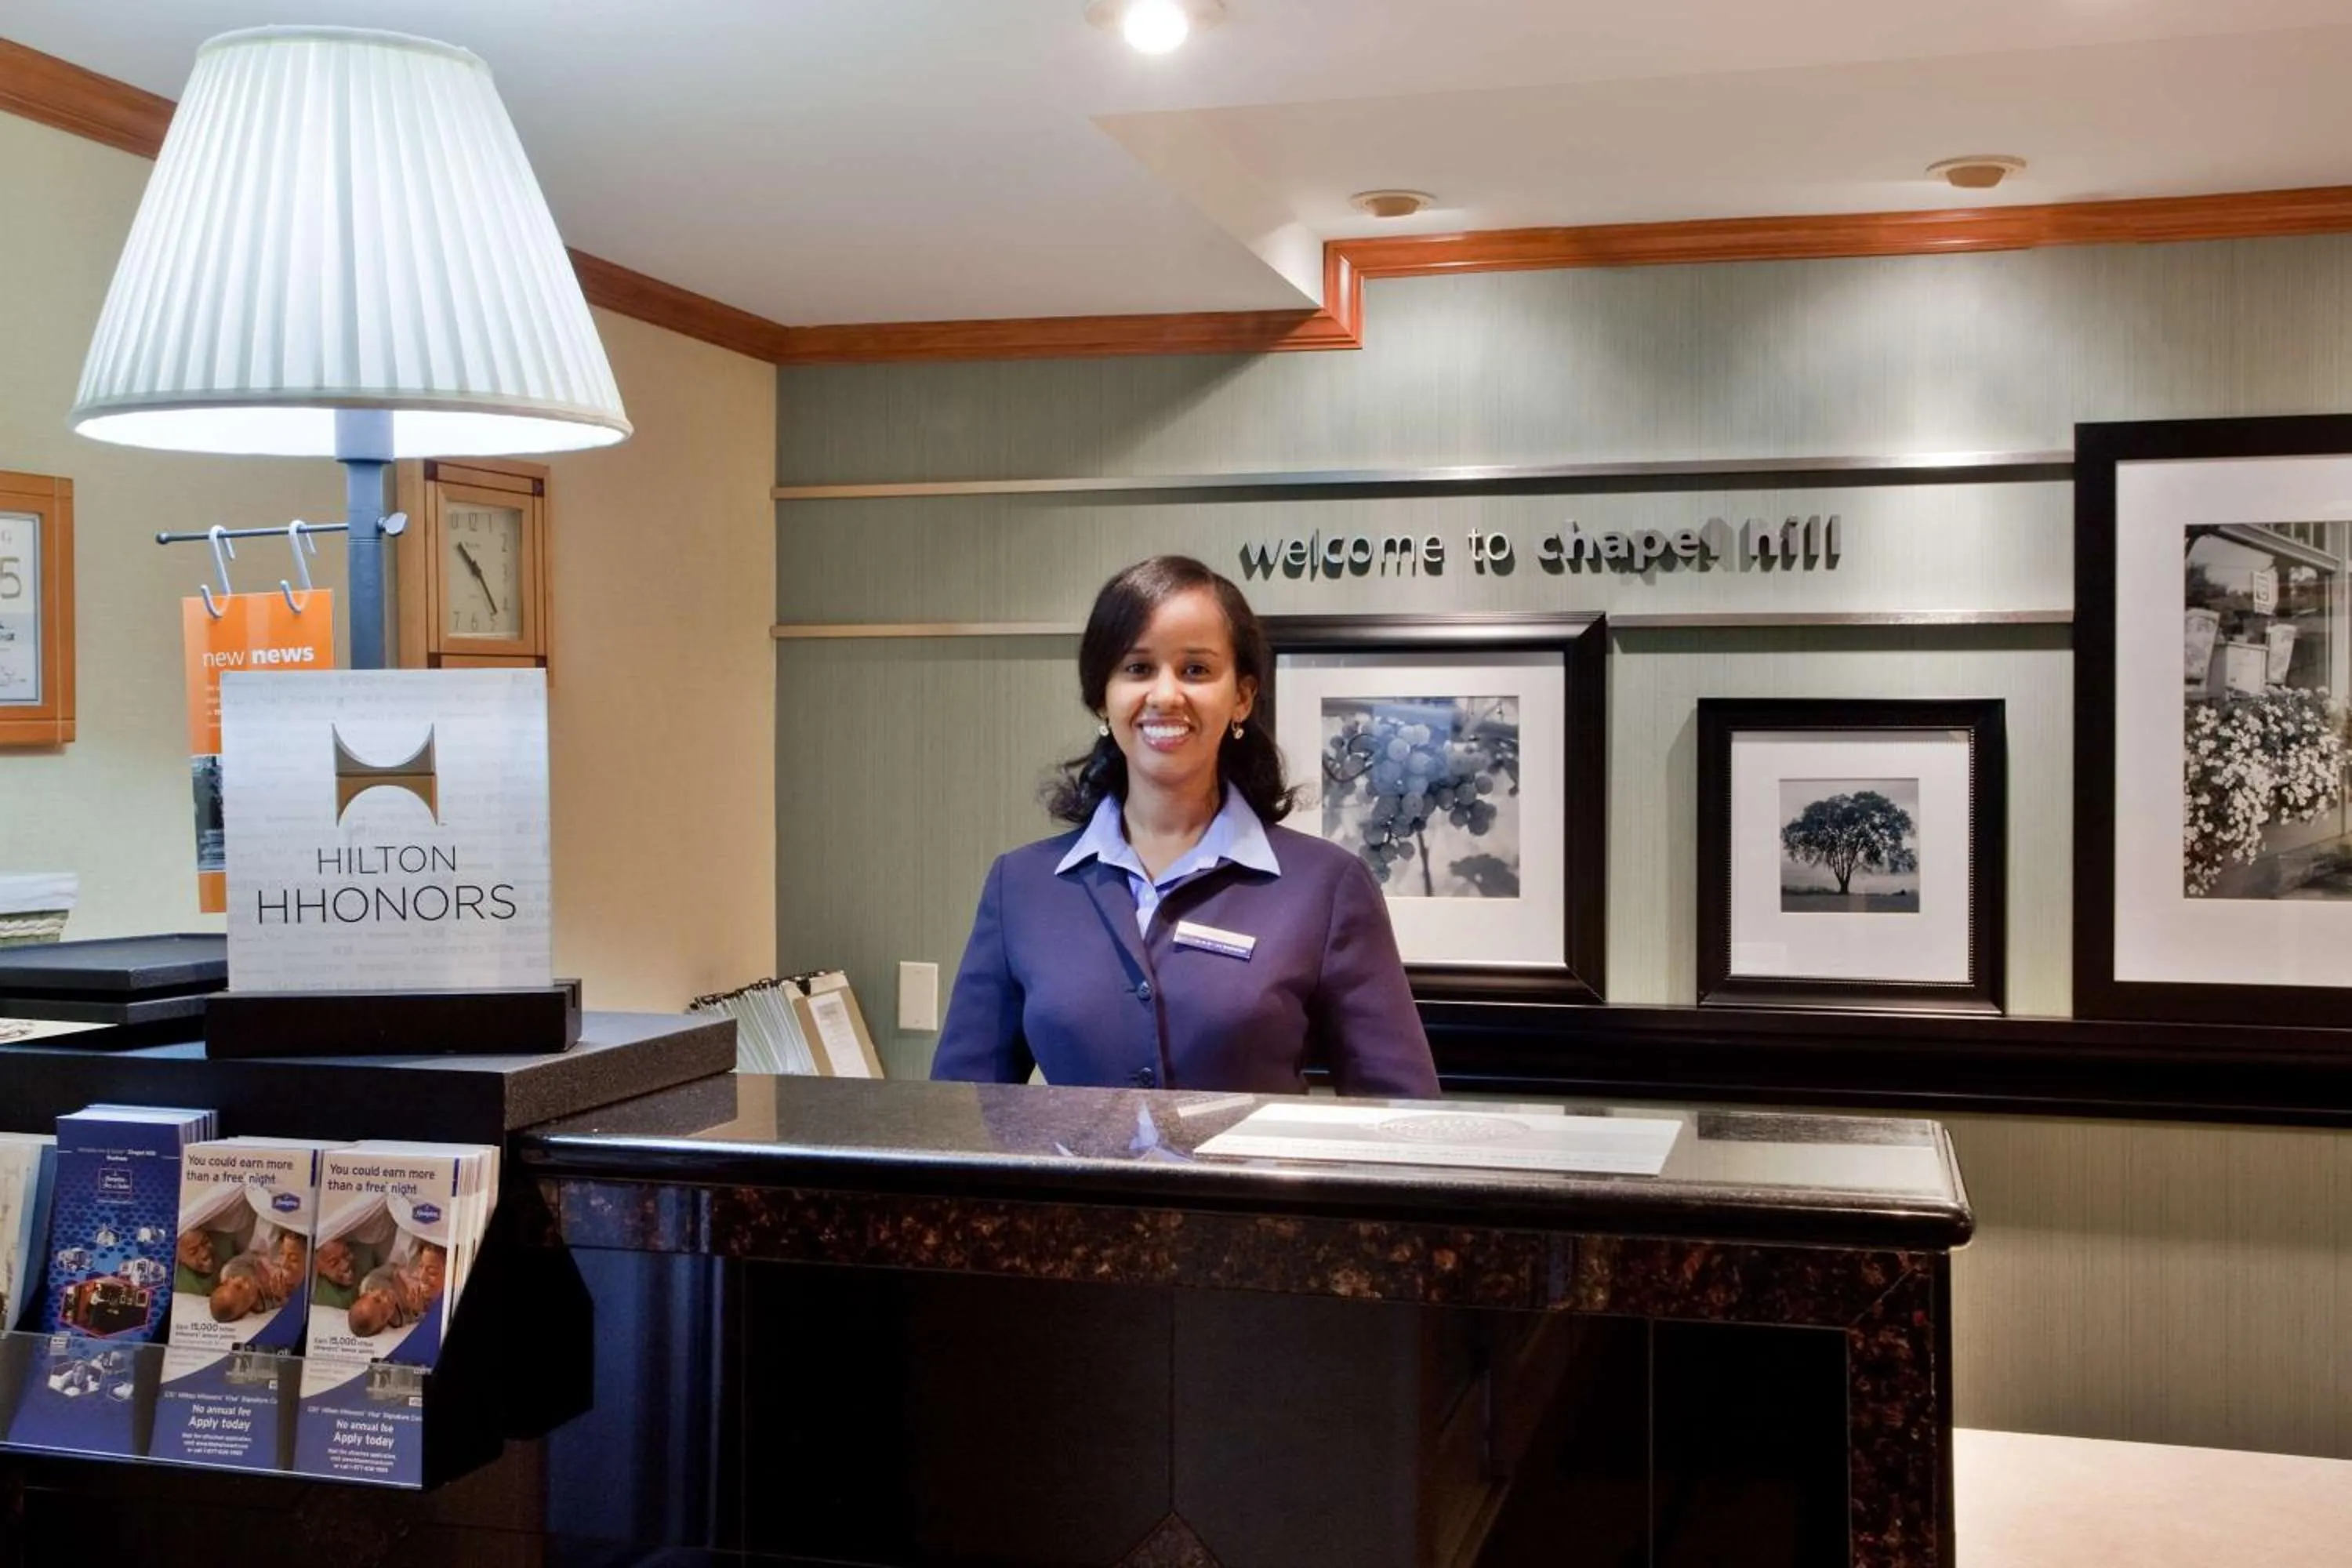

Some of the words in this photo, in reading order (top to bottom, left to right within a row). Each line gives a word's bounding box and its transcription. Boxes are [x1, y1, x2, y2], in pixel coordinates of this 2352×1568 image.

[1242, 528, 1443, 573] welcome
[1468, 527, 1513, 569] to
[1539, 517, 1722, 574] chapel
[1742, 514, 1842, 566] hill
[202, 651, 245, 667] new
[251, 646, 314, 664] news
[318, 845, 456, 874] HILTON
[258, 884, 517, 924] HHONORS
[188, 1154, 206, 1167] You
[209, 1156, 237, 1168] could
[239, 1160, 264, 1169] earn
[267, 1160, 294, 1171] more
[187, 1170, 209, 1182] than
[212, 1174, 220, 1182] a
[249, 1172, 276, 1187] night
[329, 1163, 349, 1175] You
[352, 1166, 380, 1177] could
[383, 1168, 405, 1178] earn
[408, 1170, 436, 1180] more
[327, 1179, 353, 1192] than
[355, 1183, 363, 1192] a
[390, 1182, 417, 1196] night
[192, 1404, 205, 1414] No
[206, 1406, 236, 1416] annual
[238, 1406, 252, 1417] fee
[188, 1416, 219, 1430] Apply
[222, 1417, 251, 1432] today
[336, 1419, 349, 1429] No
[350, 1421, 379, 1432] annual
[380, 1423, 394, 1434] fee
[333, 1432, 363, 1446] Apply
[365, 1434, 394, 1450] today
